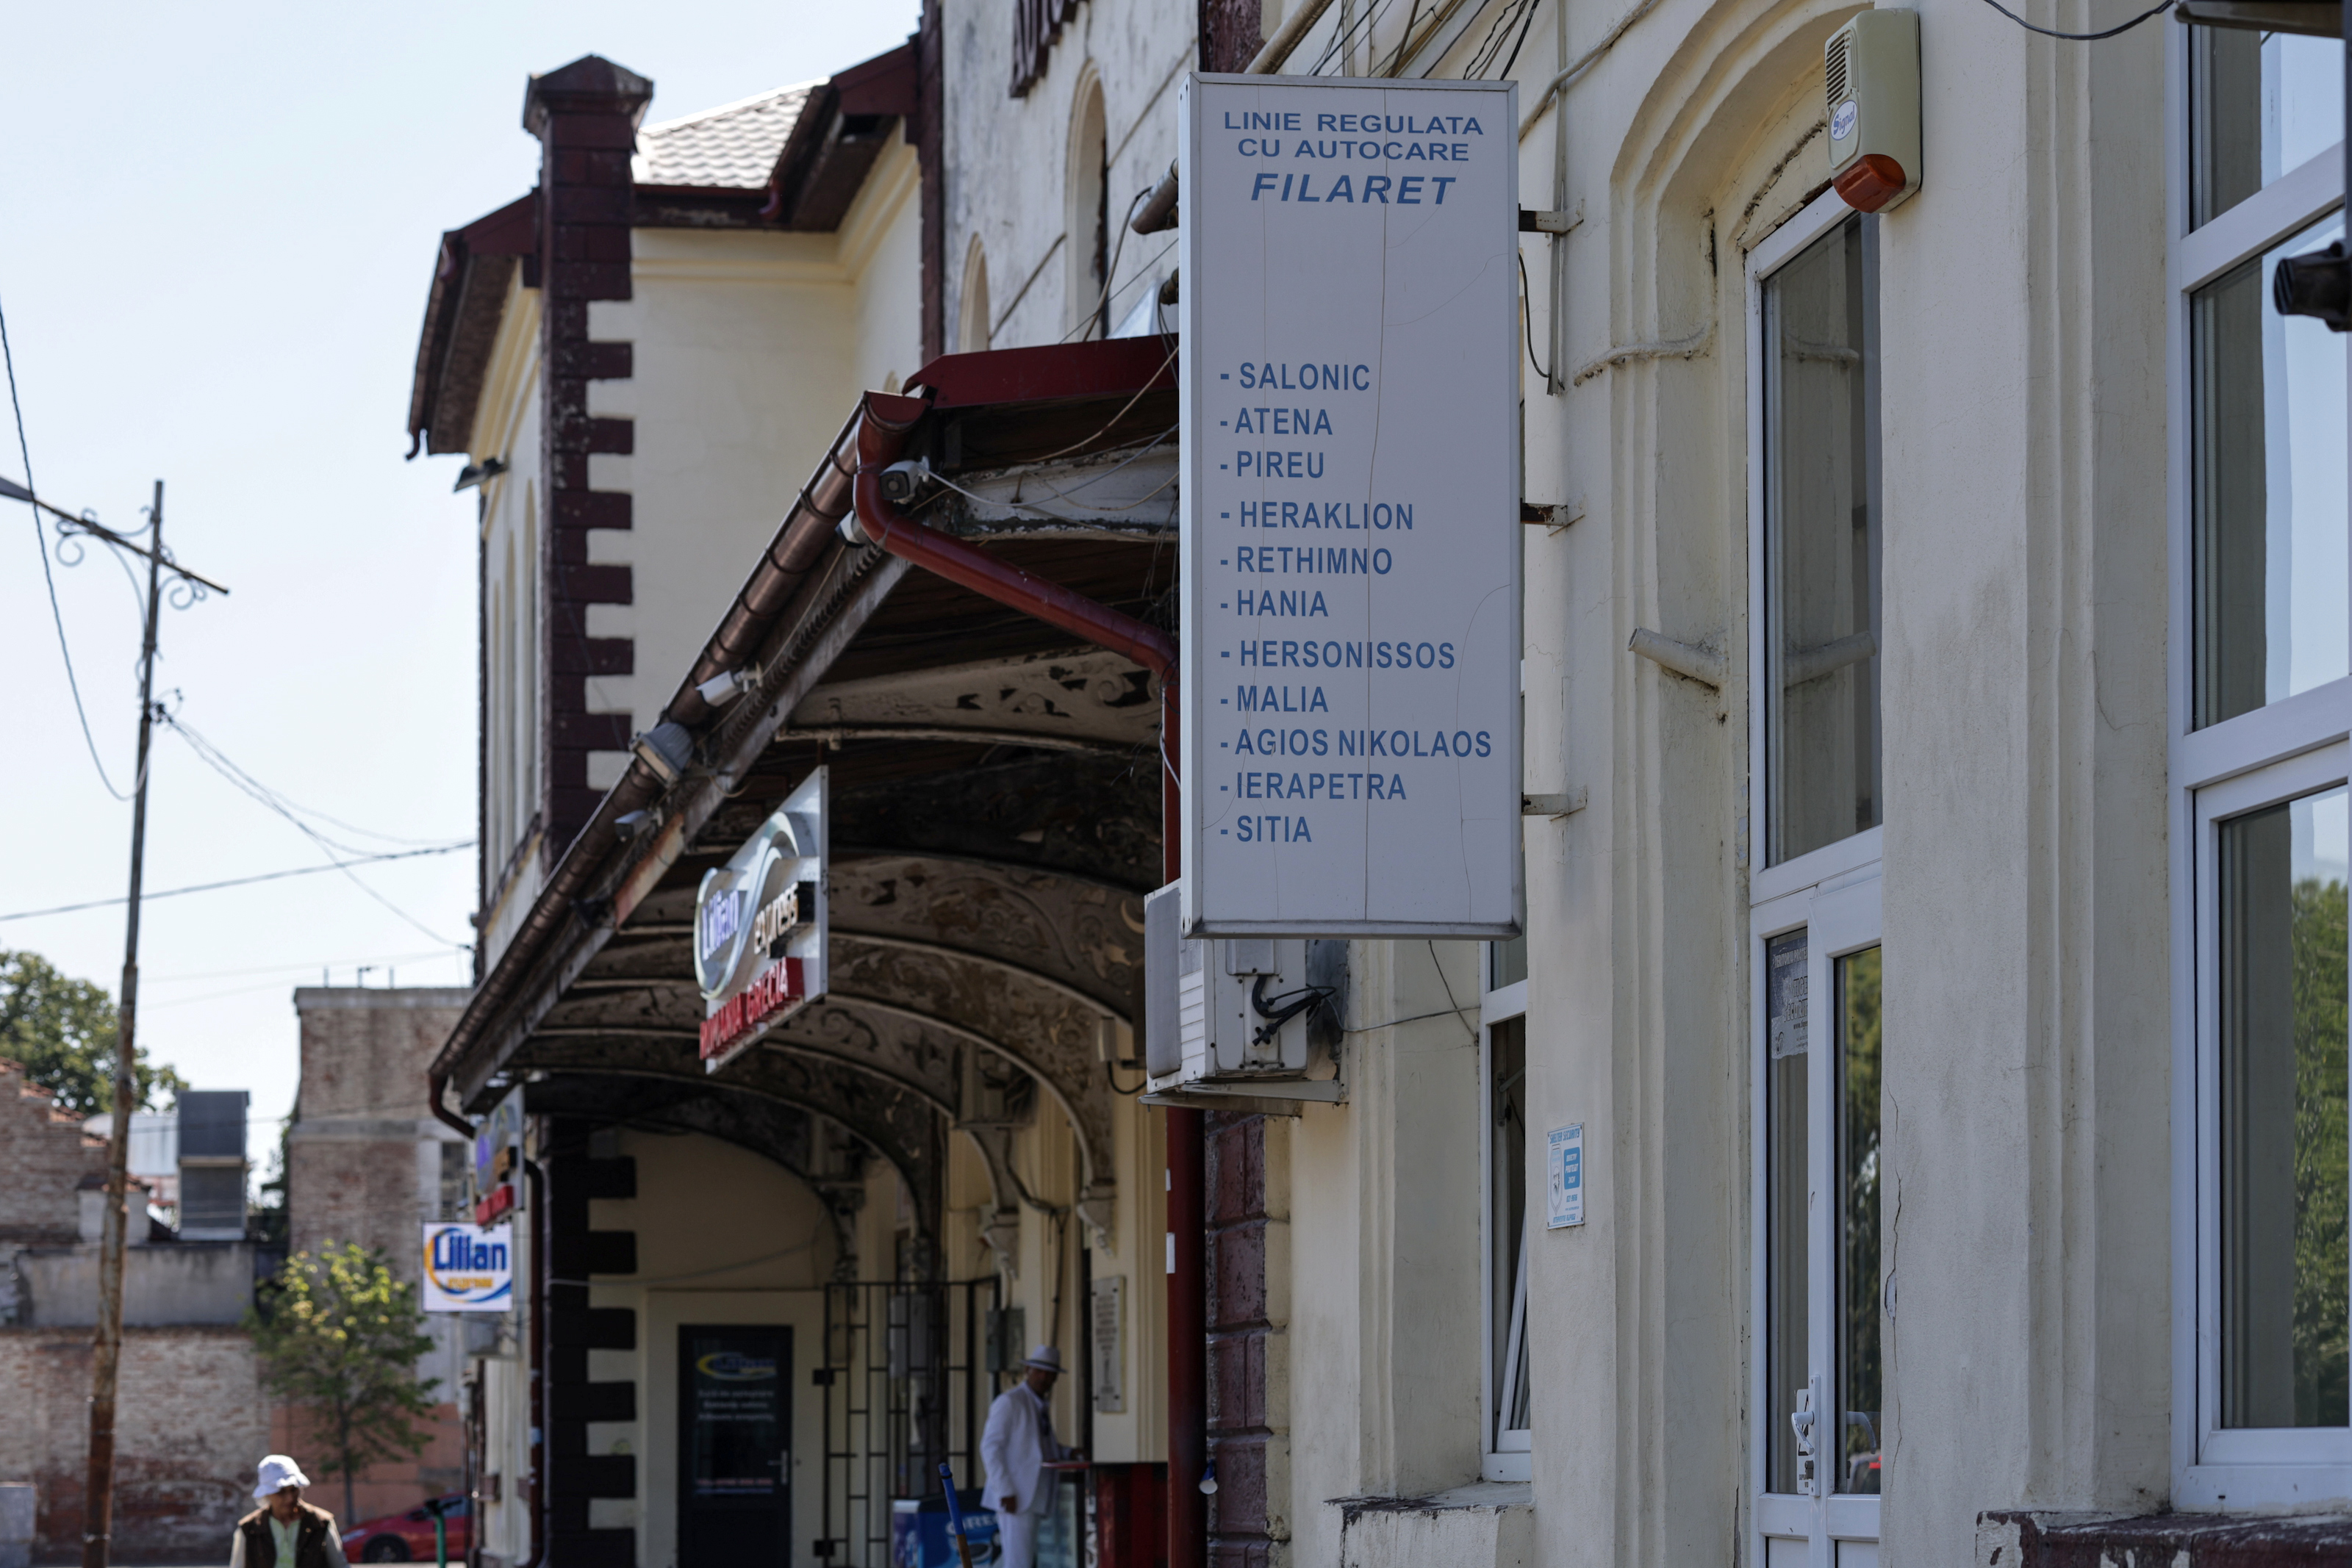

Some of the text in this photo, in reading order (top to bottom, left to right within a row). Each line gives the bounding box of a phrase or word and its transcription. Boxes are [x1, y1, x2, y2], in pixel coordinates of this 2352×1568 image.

[1224, 112, 1484, 136] LINIE REGULATA
[1833, 104, 1855, 135] Signal
[1238, 138, 1469, 162] CU AUTOCARE
[1251, 173, 1456, 205] FILARET
[1239, 362, 1371, 391] SALONIC
[1235, 408, 1333, 435] ATENA
[1237, 450, 1324, 479] PIREU
[1241, 501, 1414, 531] HERAKLION
[1238, 546, 1393, 575] RETHIMNO
[1238, 590, 1329, 617] HANIA
[1241, 641, 1456, 669] HERSONISSOS
[1238, 686, 1329, 713] MALIA
[1236, 729, 1329, 757] AGIOS
[1338, 730, 1492, 758] NIKOLAOS
[1238, 772, 1407, 800] IERAPETRA
[1237, 816, 1313, 843] SITIA
[1793, 975, 1808, 998] TIGE
[1563, 1128, 1580, 1141] SECURITY
[434, 1234, 507, 1271] Lilian
